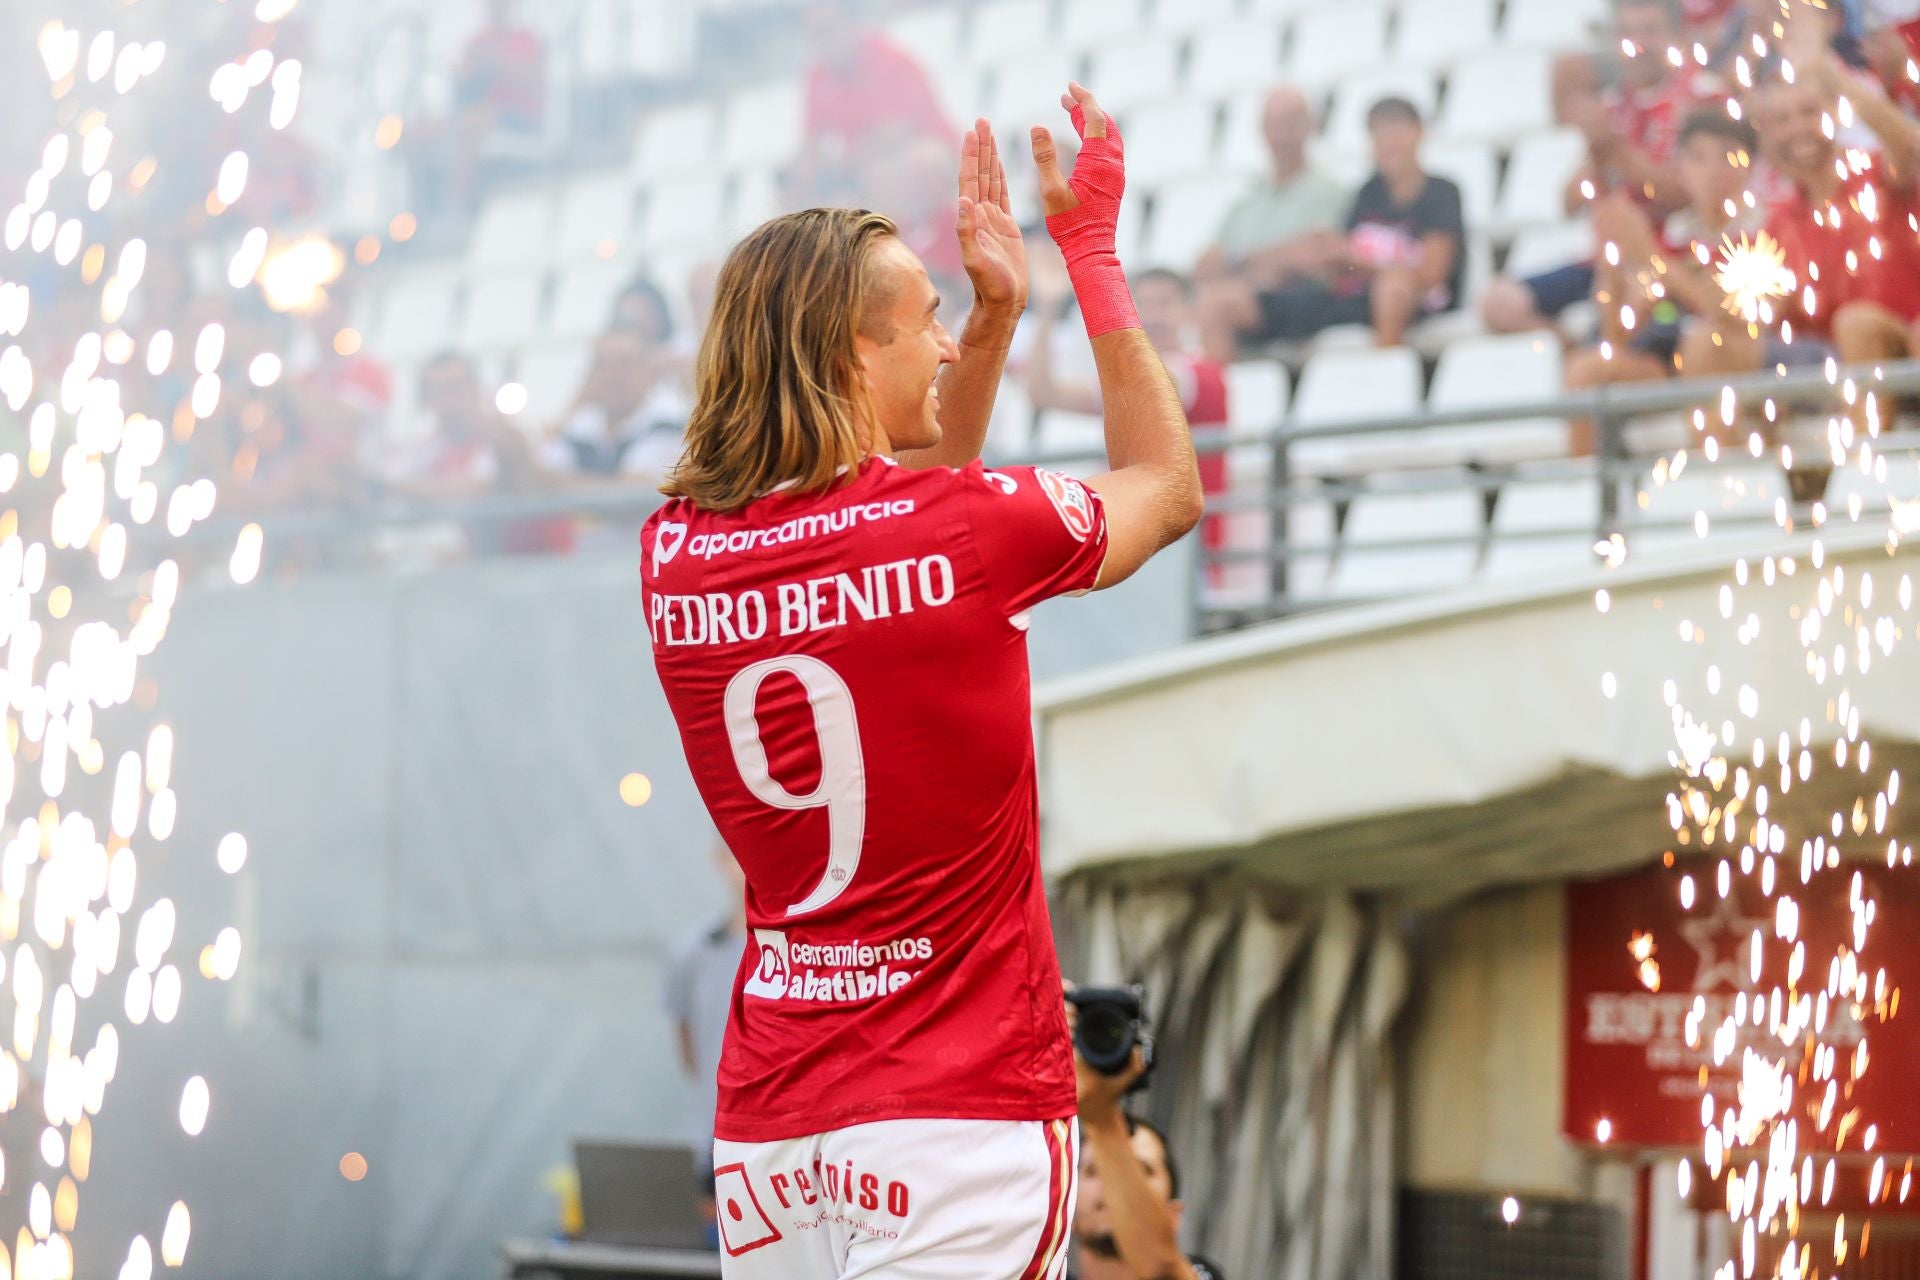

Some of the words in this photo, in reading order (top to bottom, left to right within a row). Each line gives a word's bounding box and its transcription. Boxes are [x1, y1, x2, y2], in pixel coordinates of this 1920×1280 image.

[688, 499, 914, 560] aparcamurcia
[651, 590, 768, 646] PEDRO
[777, 554, 955, 637] BENITO
[723, 653, 866, 917] 9
[791, 937, 933, 967] cerramientos
[788, 965, 923, 1002] abatible
